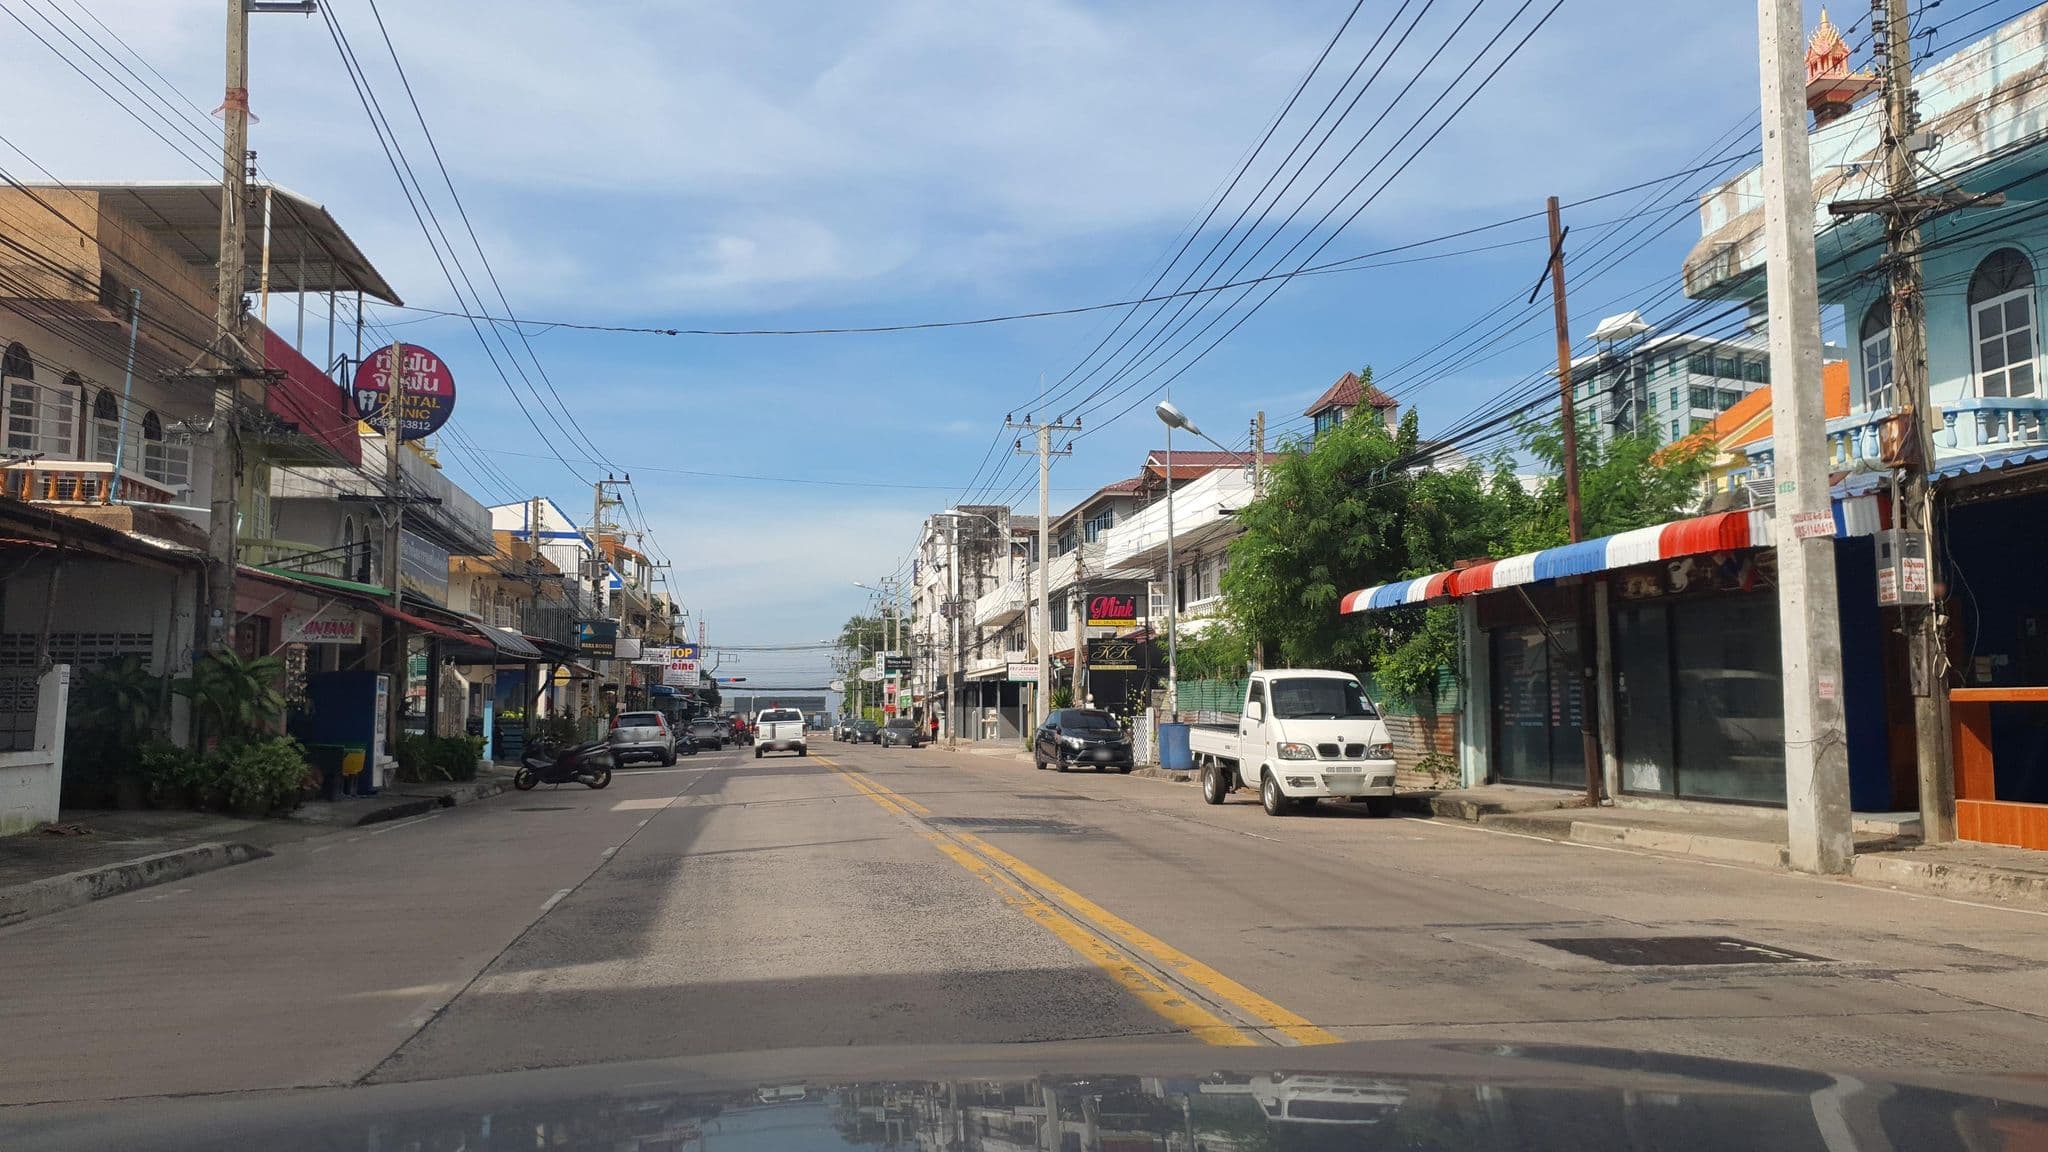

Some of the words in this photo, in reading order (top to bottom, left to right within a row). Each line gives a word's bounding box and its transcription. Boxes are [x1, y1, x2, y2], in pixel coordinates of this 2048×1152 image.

[378, 392, 441, 408] DNTAL
[382, 406, 431, 419] CINIC
[1090, 595, 1134, 619] Mink
